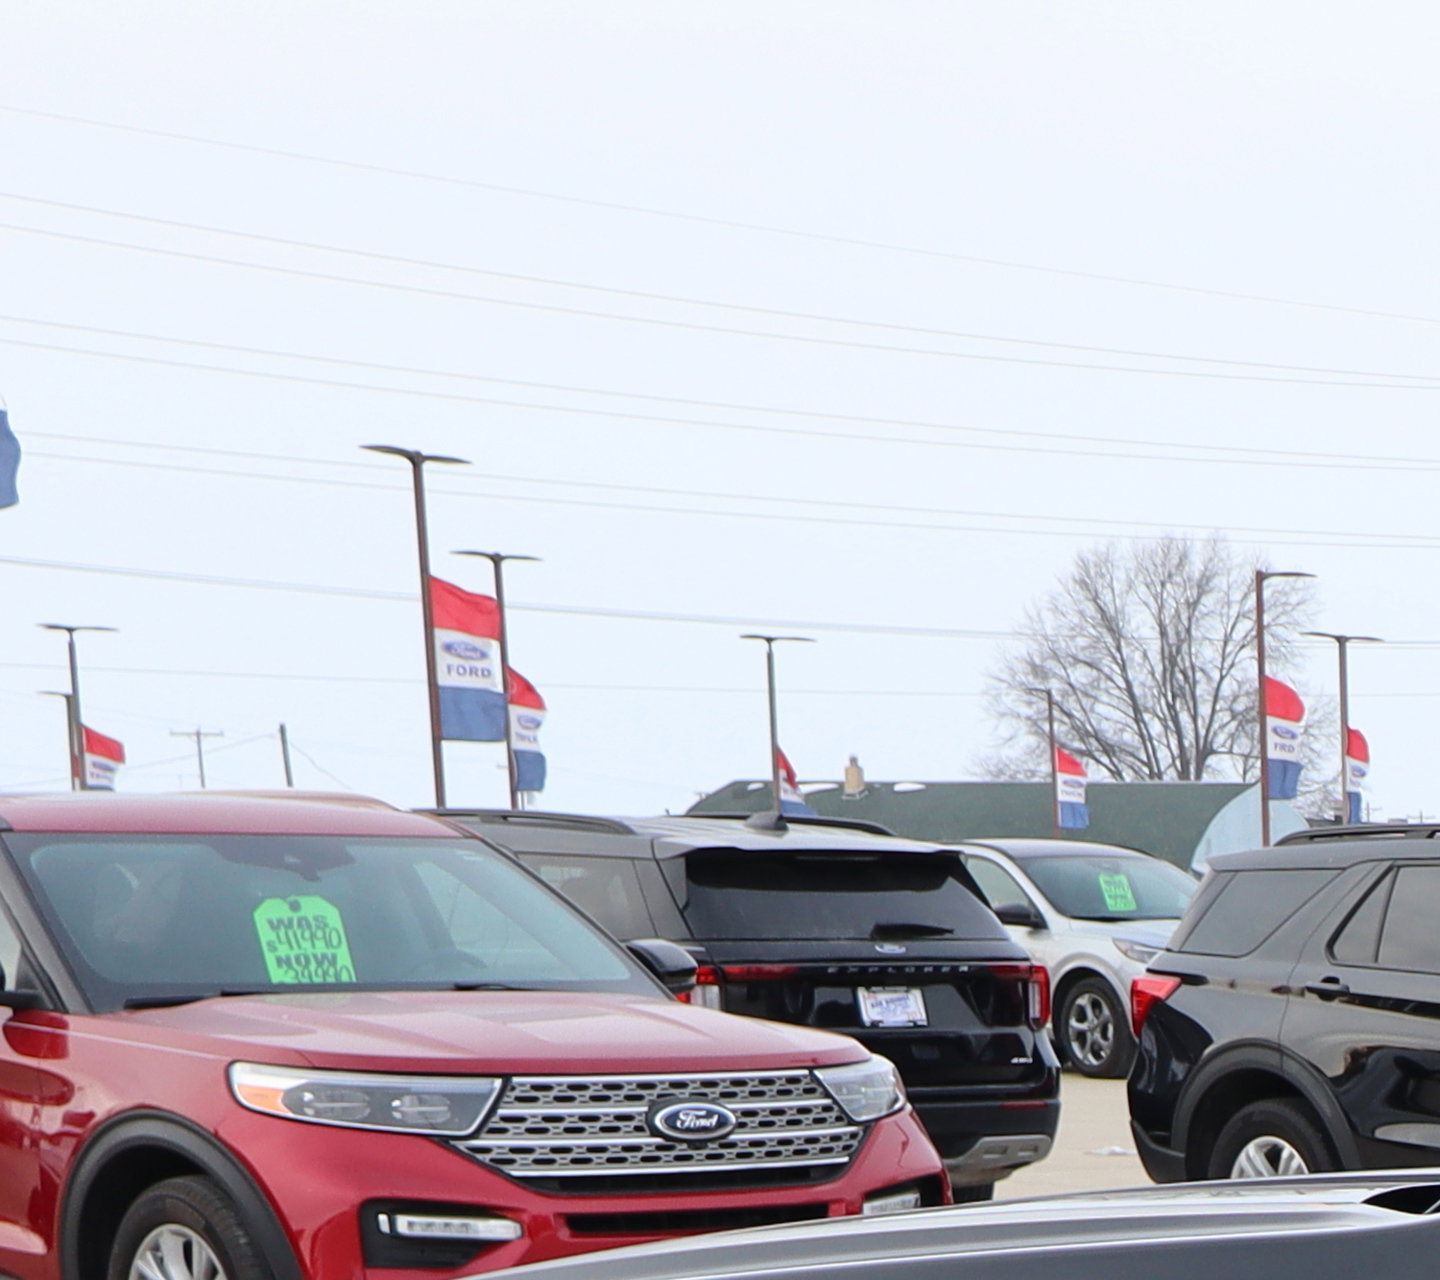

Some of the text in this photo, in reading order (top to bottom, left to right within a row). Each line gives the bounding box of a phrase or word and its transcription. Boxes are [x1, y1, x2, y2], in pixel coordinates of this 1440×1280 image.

[445, 663, 492, 678] FORD
[266, 915, 329, 931] WAS
[275, 953, 338, 968] NOW
[827, 965, 969, 974] EXPLORER
[676, 1110, 719, 1129] Ford
